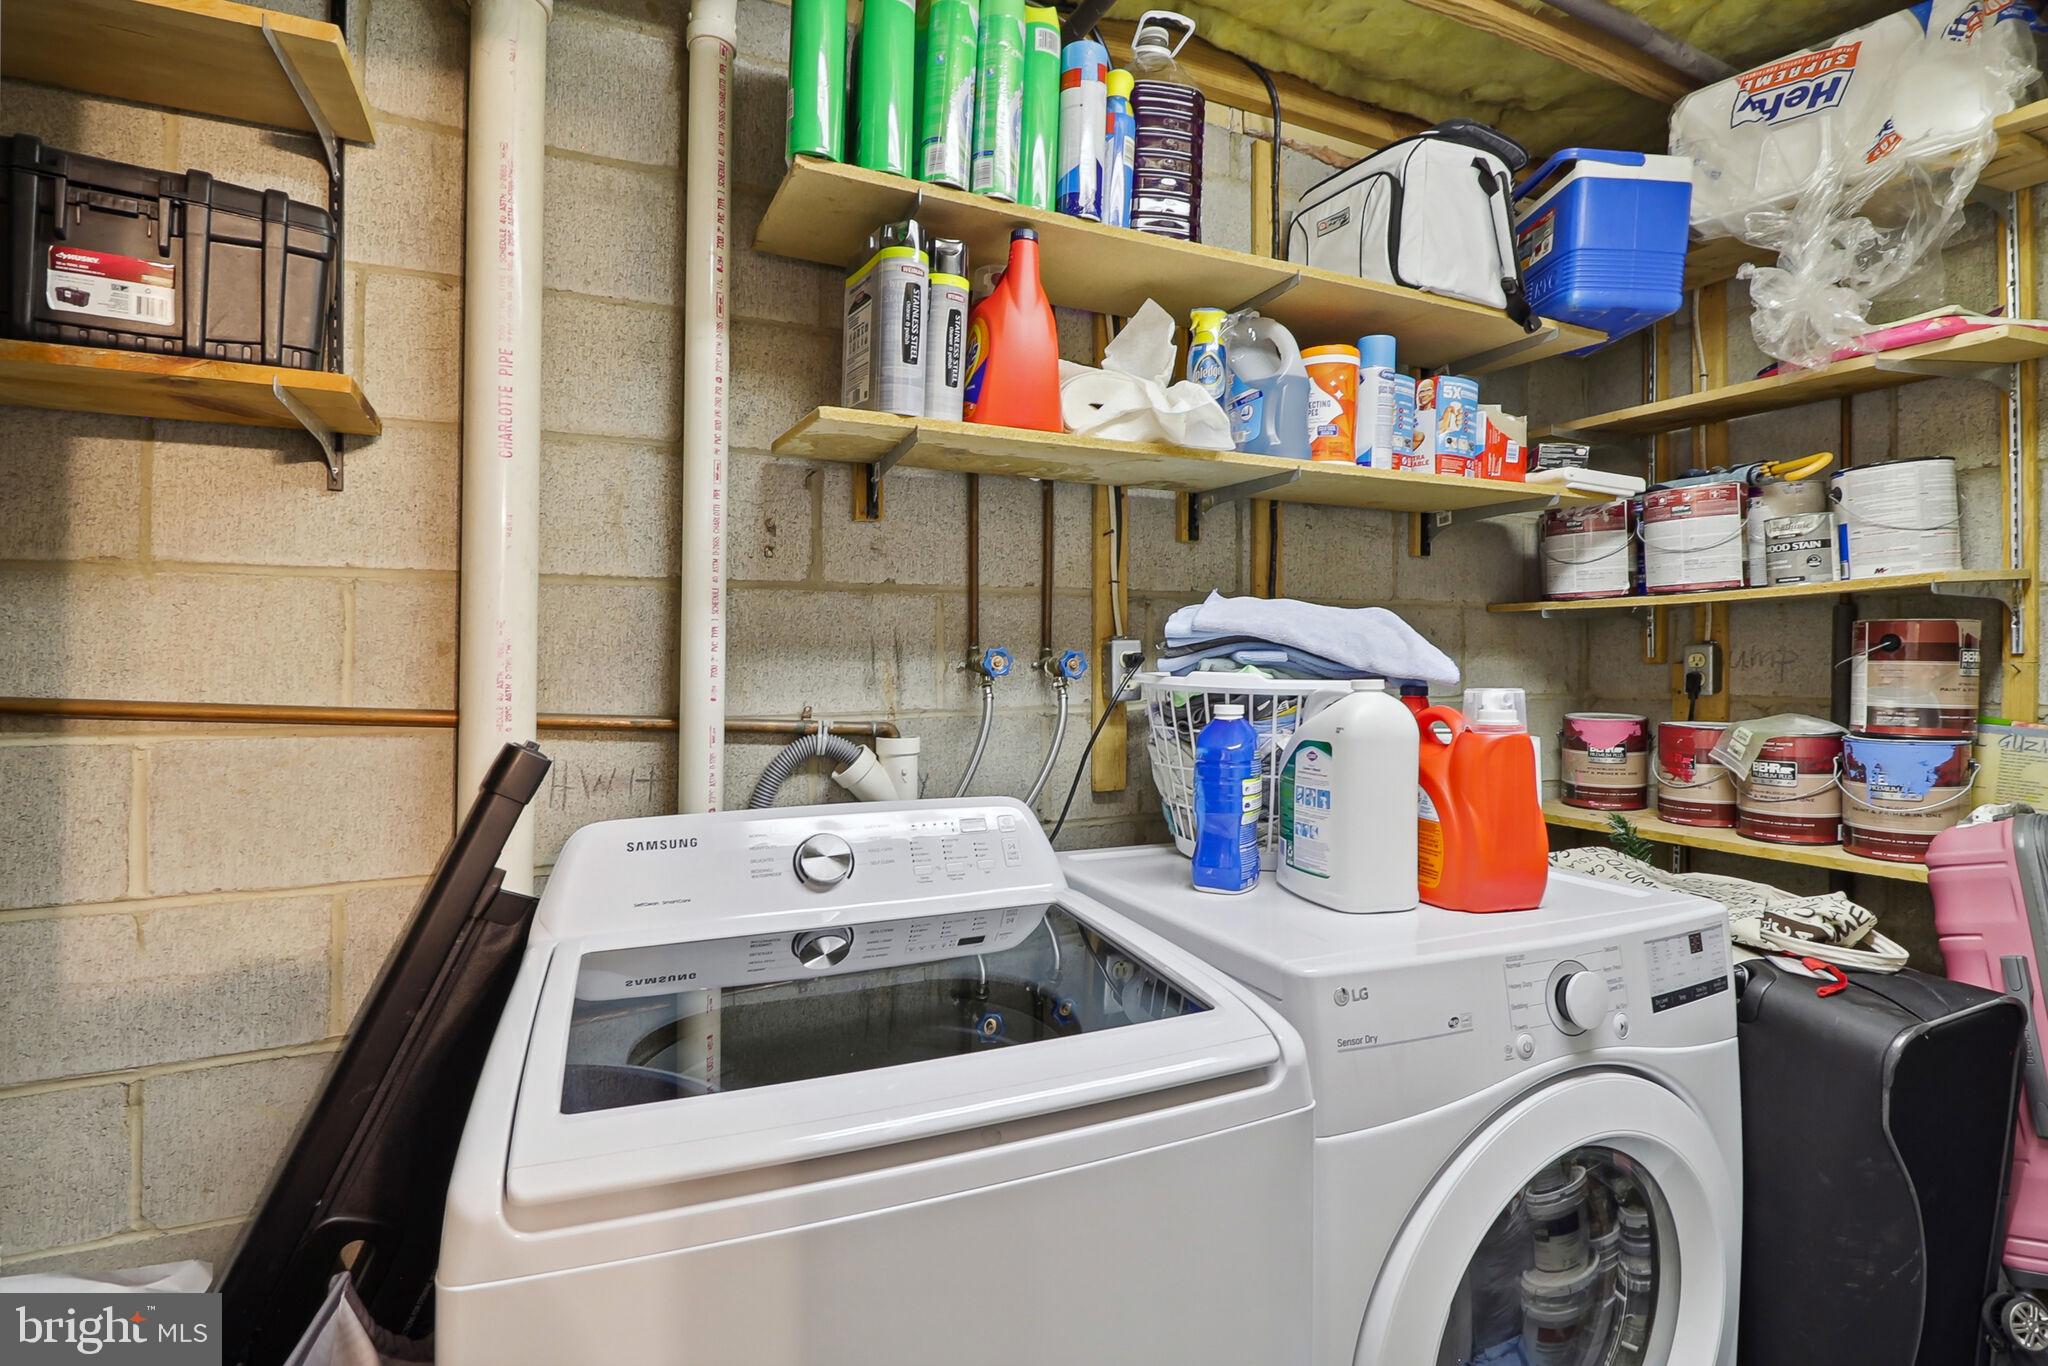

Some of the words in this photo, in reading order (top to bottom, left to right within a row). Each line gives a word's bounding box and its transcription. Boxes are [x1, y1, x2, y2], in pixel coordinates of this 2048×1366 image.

[1743, 53, 1848, 91] SUPREME
[718, 78, 726, 109] CHARLOTTE
[911, 288, 920, 335] STAINLESS
[910, 335, 918, 359] STEEL
[953, 315, 961, 360] STAINLESS
[498, 347, 513, 377] PIPE
[1443, 385, 1462, 399] 5X
[498, 385, 513, 458] CHARLOTTE
[1792, 540, 1821, 550] STAIN
[1753, 762, 1780, 773] BEHR
[627, 837, 698, 852] SAMSUNG
[1352, 987, 1369, 1002] LG
[1337, 1036, 1364, 1048] Sensor
[1365, 1034, 1378, 1044] Dry
